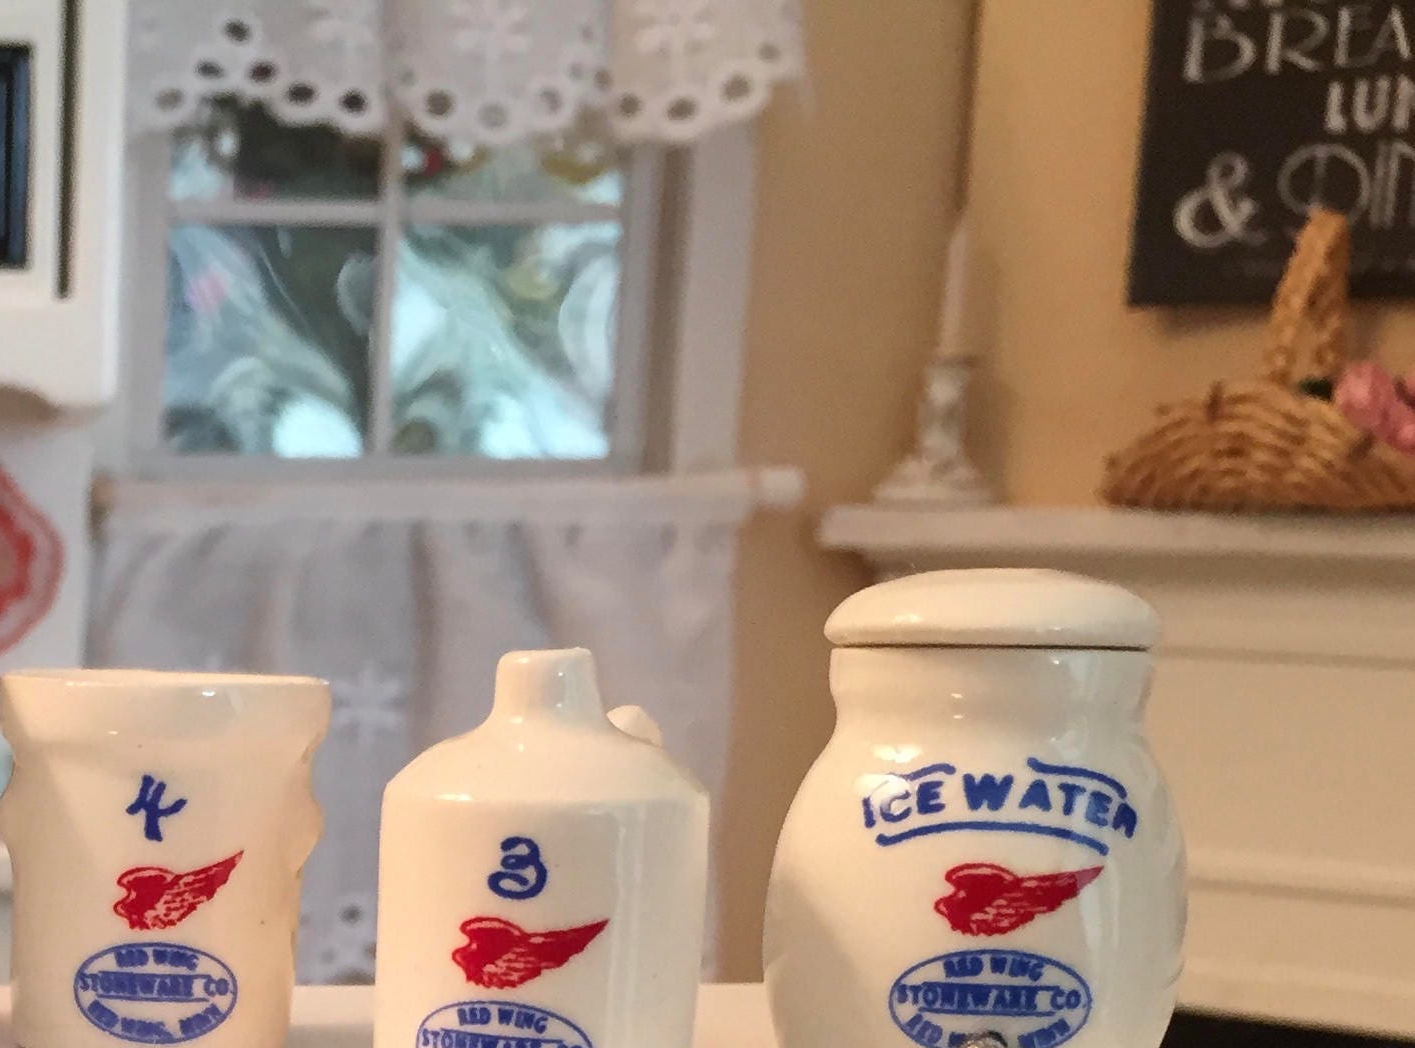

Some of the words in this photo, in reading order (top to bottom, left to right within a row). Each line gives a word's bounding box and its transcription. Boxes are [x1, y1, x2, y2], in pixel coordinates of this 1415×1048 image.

[126, 774, 187, 842] 4
[862, 780, 946, 829] ICE
[962, 773, 1137, 839] WATER
[488, 836, 547, 900] 3
[457, 1007, 491, 1026] RED
[497, 1007, 548, 1034] WING
